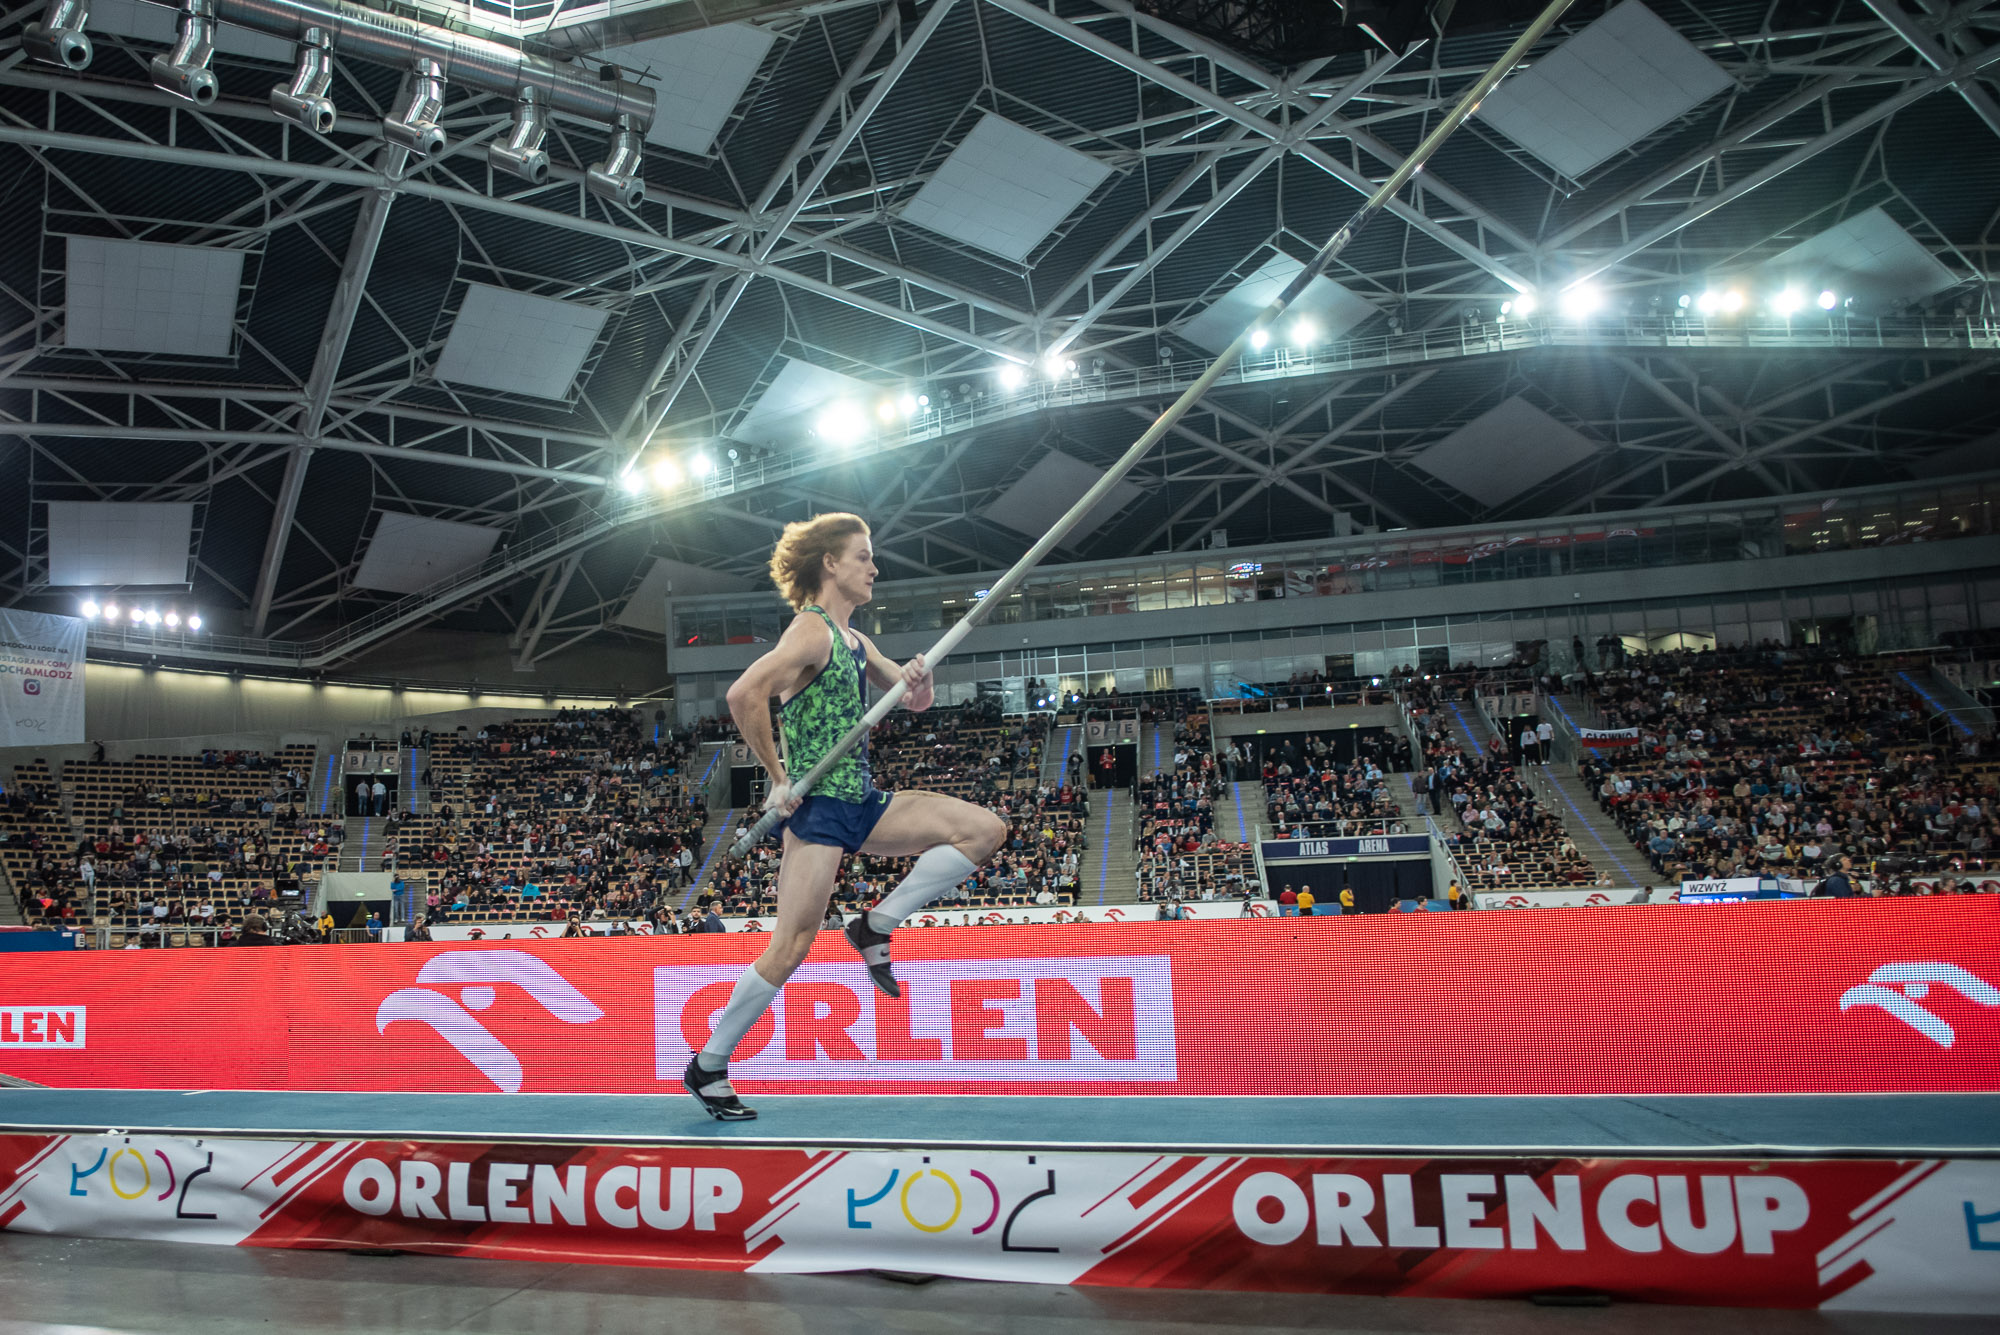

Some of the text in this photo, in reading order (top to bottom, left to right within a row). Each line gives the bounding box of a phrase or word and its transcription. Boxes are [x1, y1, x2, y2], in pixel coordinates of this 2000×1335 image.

[0, 641, 36, 651] OKOCHAJ
[0, 655, 72, 670] STAGRAM.COM/
[1299, 838, 1390, 856] ATLAS ARENA
[1689, 880, 1727, 893] WZWYŻ
[680, 976, 1137, 1063] ORLEN
[343, 1157, 743, 1231] ORLEN CUP
[1232, 1171, 1810, 1255] ORLEN CUP
